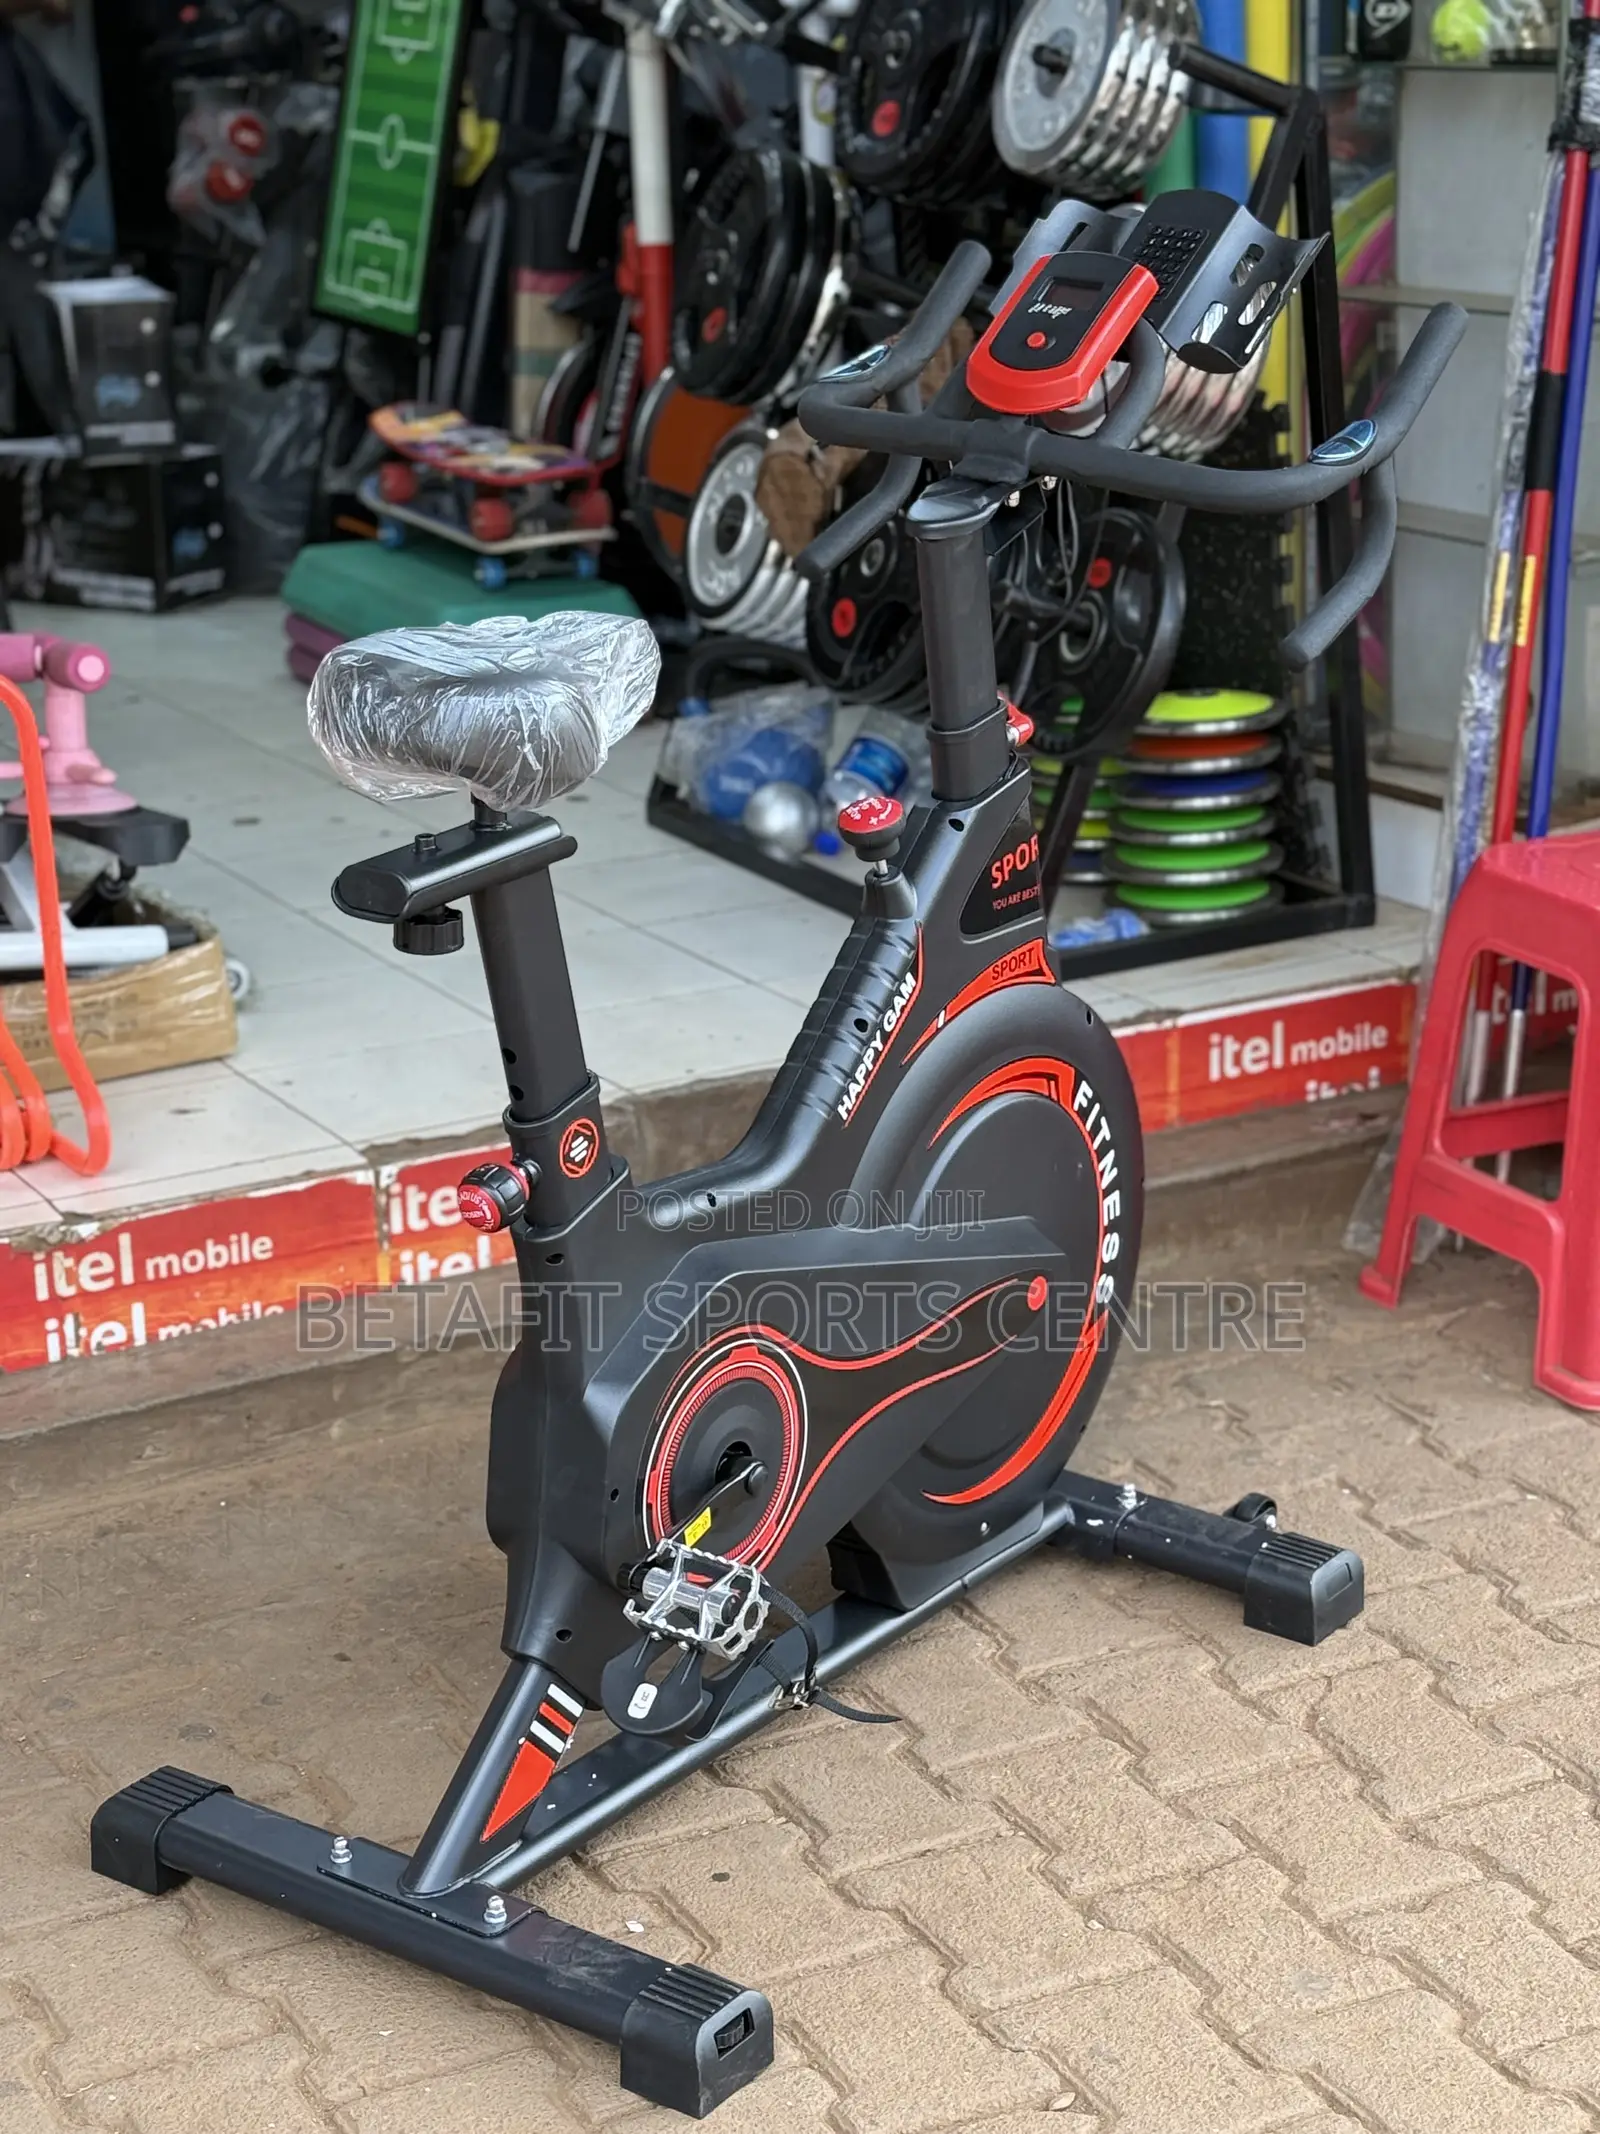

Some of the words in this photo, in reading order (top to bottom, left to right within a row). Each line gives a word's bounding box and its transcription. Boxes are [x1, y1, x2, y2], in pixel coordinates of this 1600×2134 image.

[992, 896, 1007, 911] YOU
[1008, 891, 1021, 905] ARE
[992, 947, 1035, 981] SPORT
[837, 1030, 883, 1120] HAPPY
[883, 972, 917, 1032] GAM
[1208, 1020, 1285, 1082] itel
[1290, 1021, 1389, 1066] mobile
[1073, 1080, 1121, 1304] FITNESS
[33, 1232, 135, 1302] itel
[145, 1231, 274, 1281] mobile
